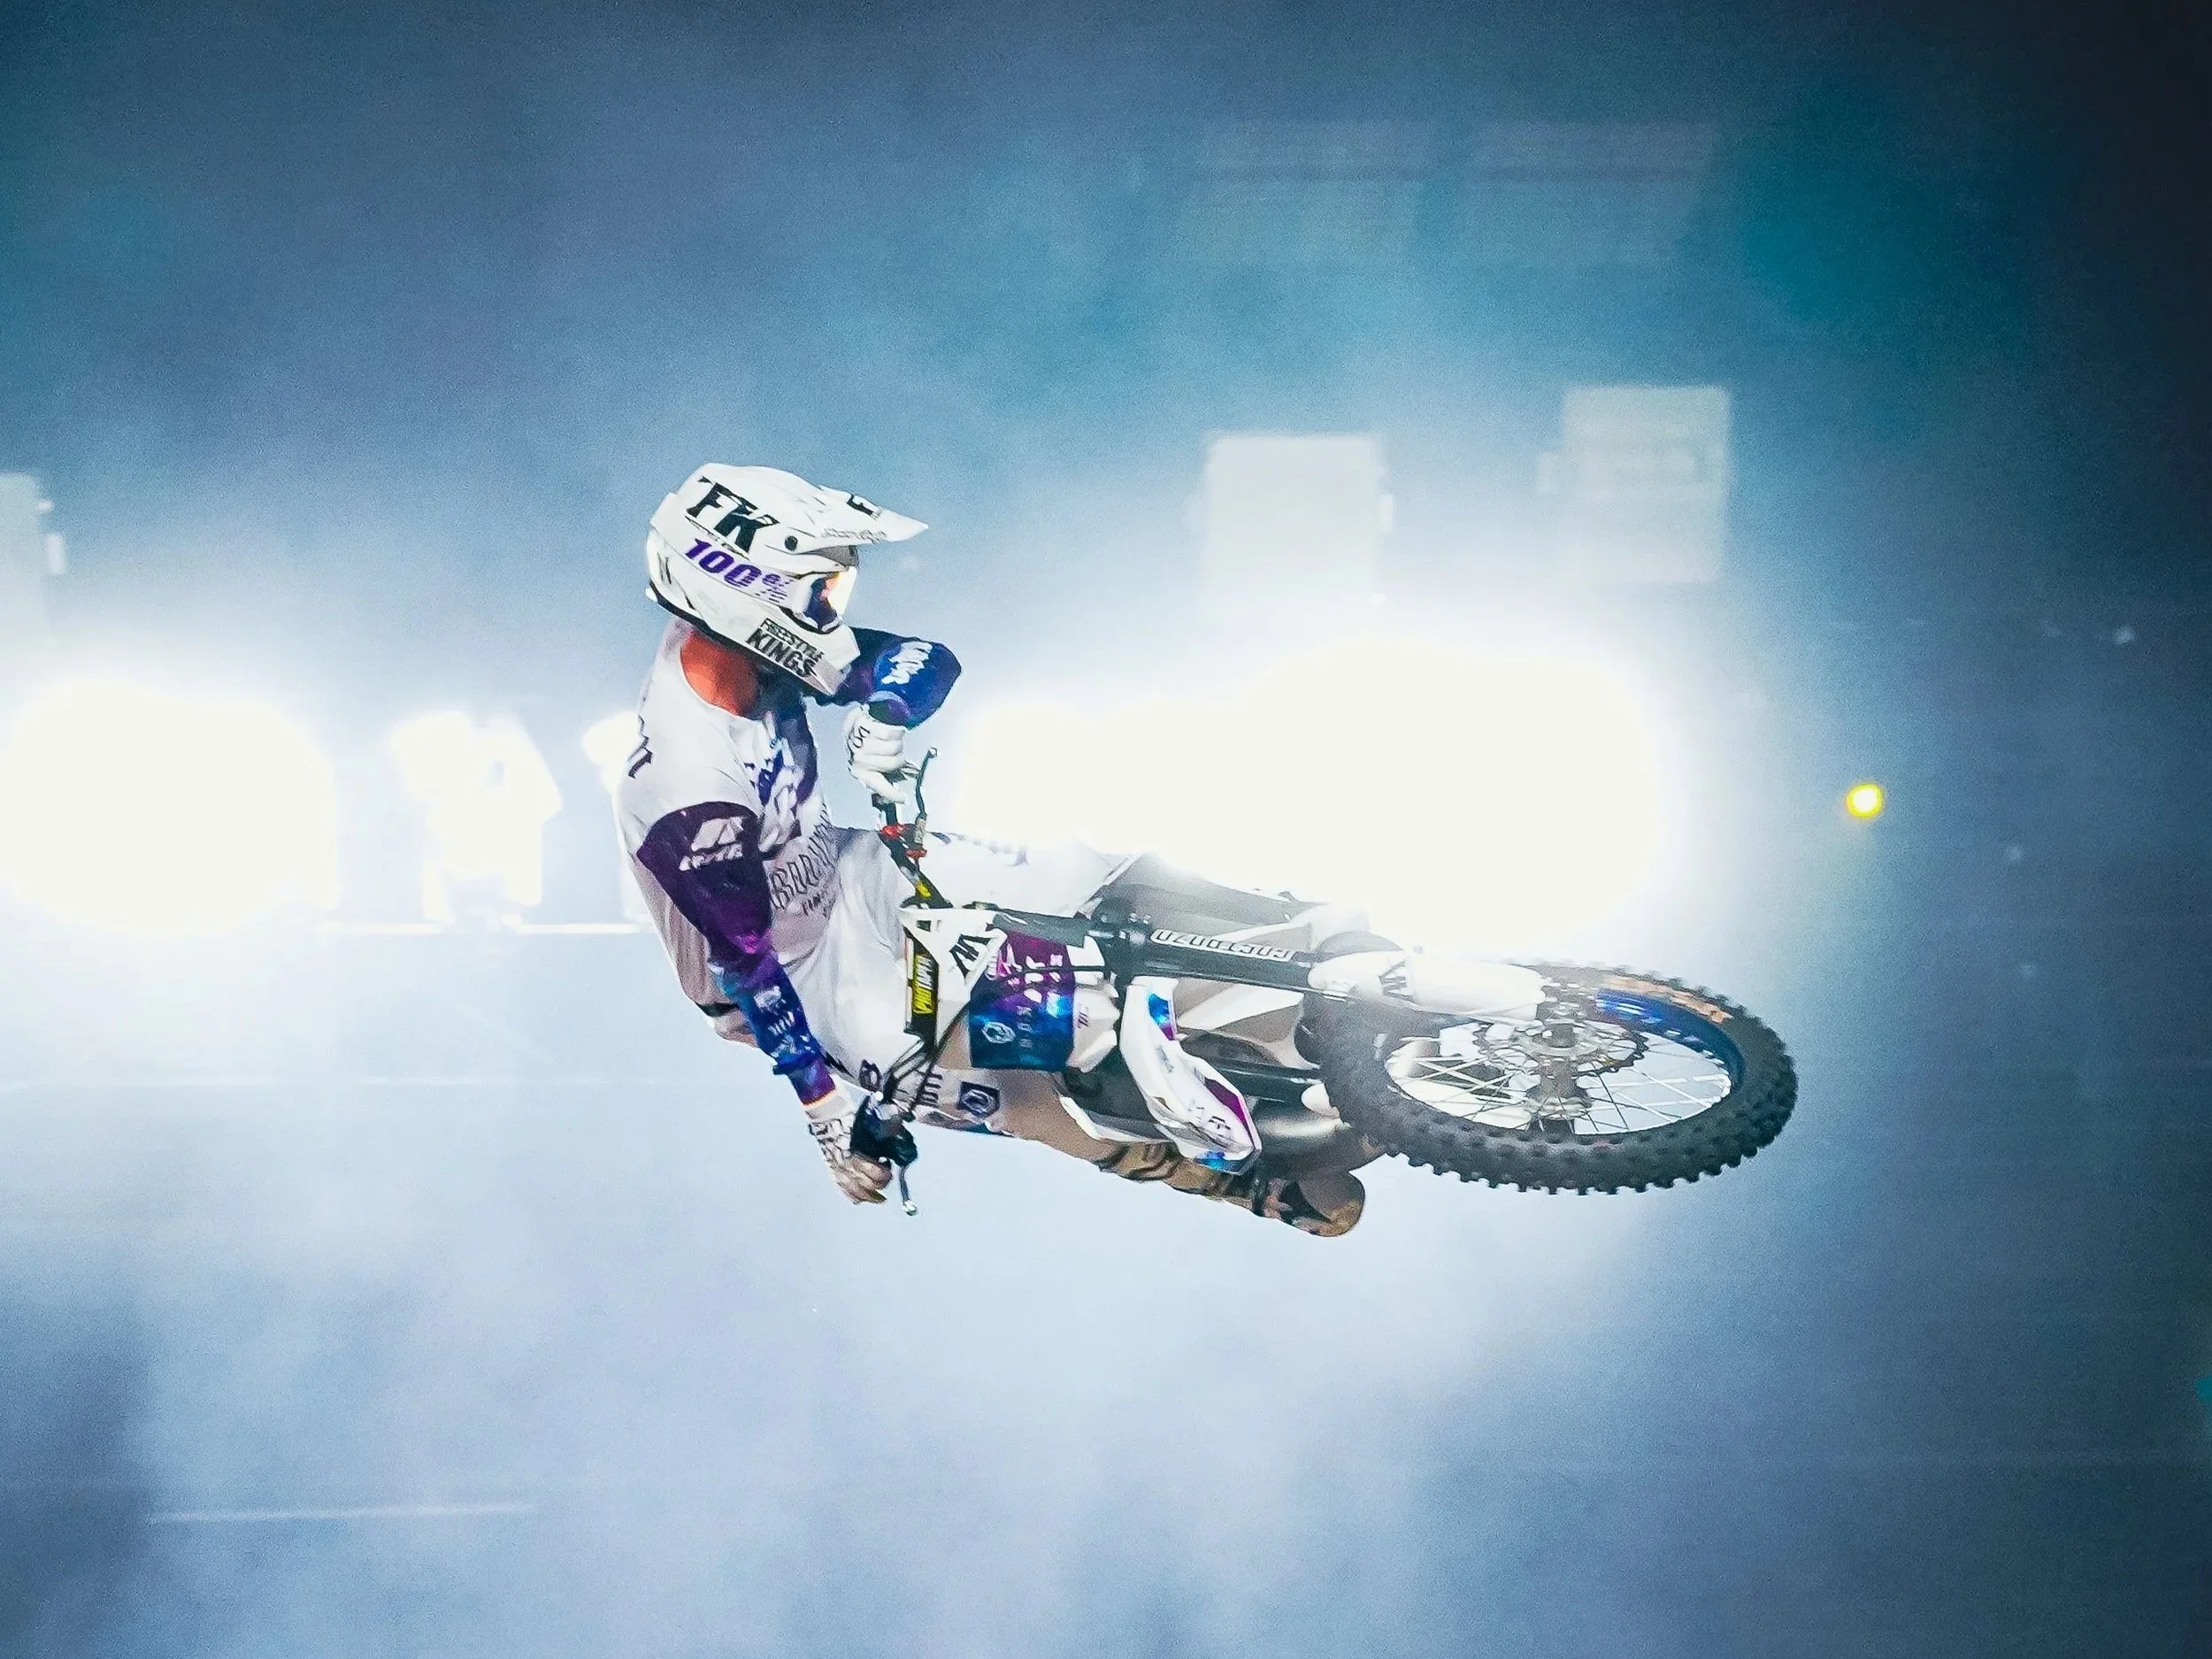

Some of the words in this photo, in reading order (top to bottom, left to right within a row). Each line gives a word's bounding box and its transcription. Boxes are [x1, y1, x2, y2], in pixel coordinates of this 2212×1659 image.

[686, 475, 780, 554] FK
[684, 538, 792, 603] 100%
[745, 627, 816, 678] KINGS
